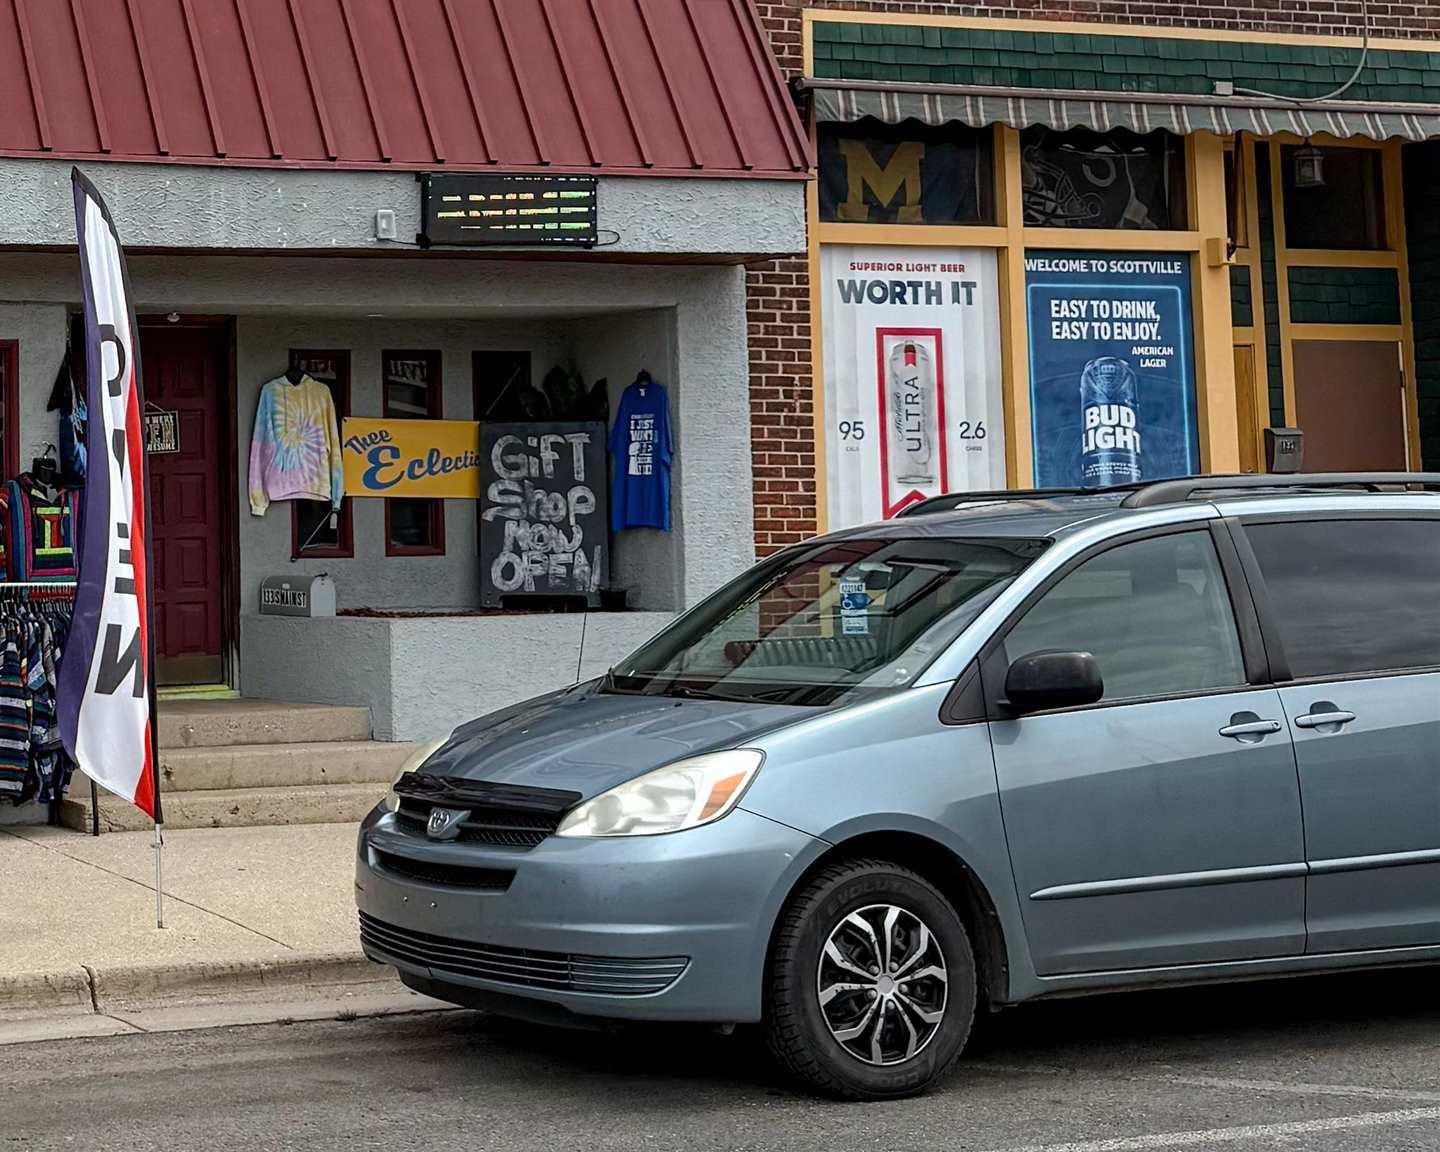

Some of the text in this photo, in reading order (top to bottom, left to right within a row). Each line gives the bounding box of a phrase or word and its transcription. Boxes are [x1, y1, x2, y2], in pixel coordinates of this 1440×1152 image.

[849, 262, 966, 273] SUPERIOR LIGHT BEER
[1024, 258, 1182, 274] WELCOME TO SCOTTVILLE
[836, 279, 977, 306] WORTH IT
[1050, 299, 1161, 322] EASY TO DRINK,
[1051, 321, 1162, 341] EASY TO ENJOY.
[1131, 346, 1174, 356] AMERICAN
[1140, 358, 1167, 368] LAGER
[904, 375, 922, 452] ULTRA
[1085, 404, 1136, 430] BUD
[838, 421, 865, 441] 95
[959, 421, 987, 440] 2.6
[1082, 426, 1141, 455] LIGHT
[343, 429, 393, 455] Thee
